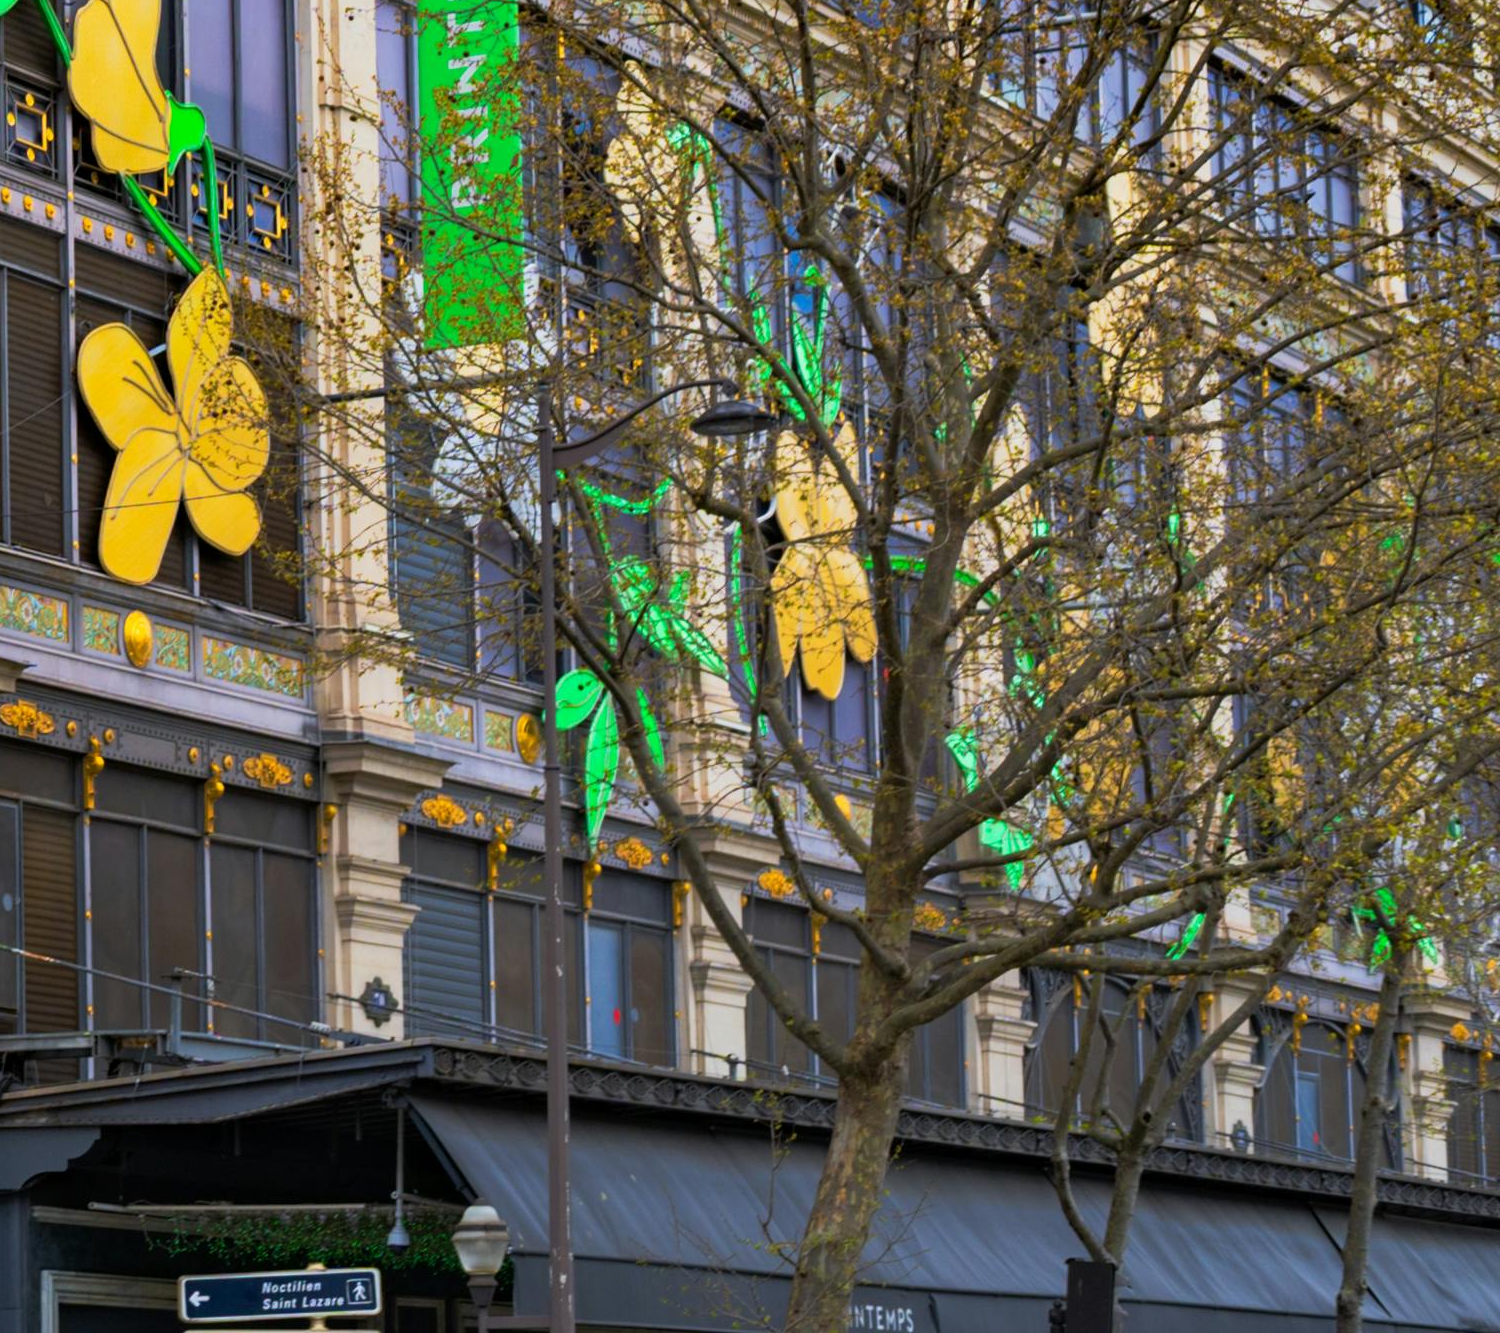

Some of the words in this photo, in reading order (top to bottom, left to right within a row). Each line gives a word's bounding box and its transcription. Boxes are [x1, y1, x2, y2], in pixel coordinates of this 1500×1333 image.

[261, 1280, 322, 1295] Noctilien
[262, 1298, 297, 1310] Saint
[302, 1296, 345, 1309] Lazare
